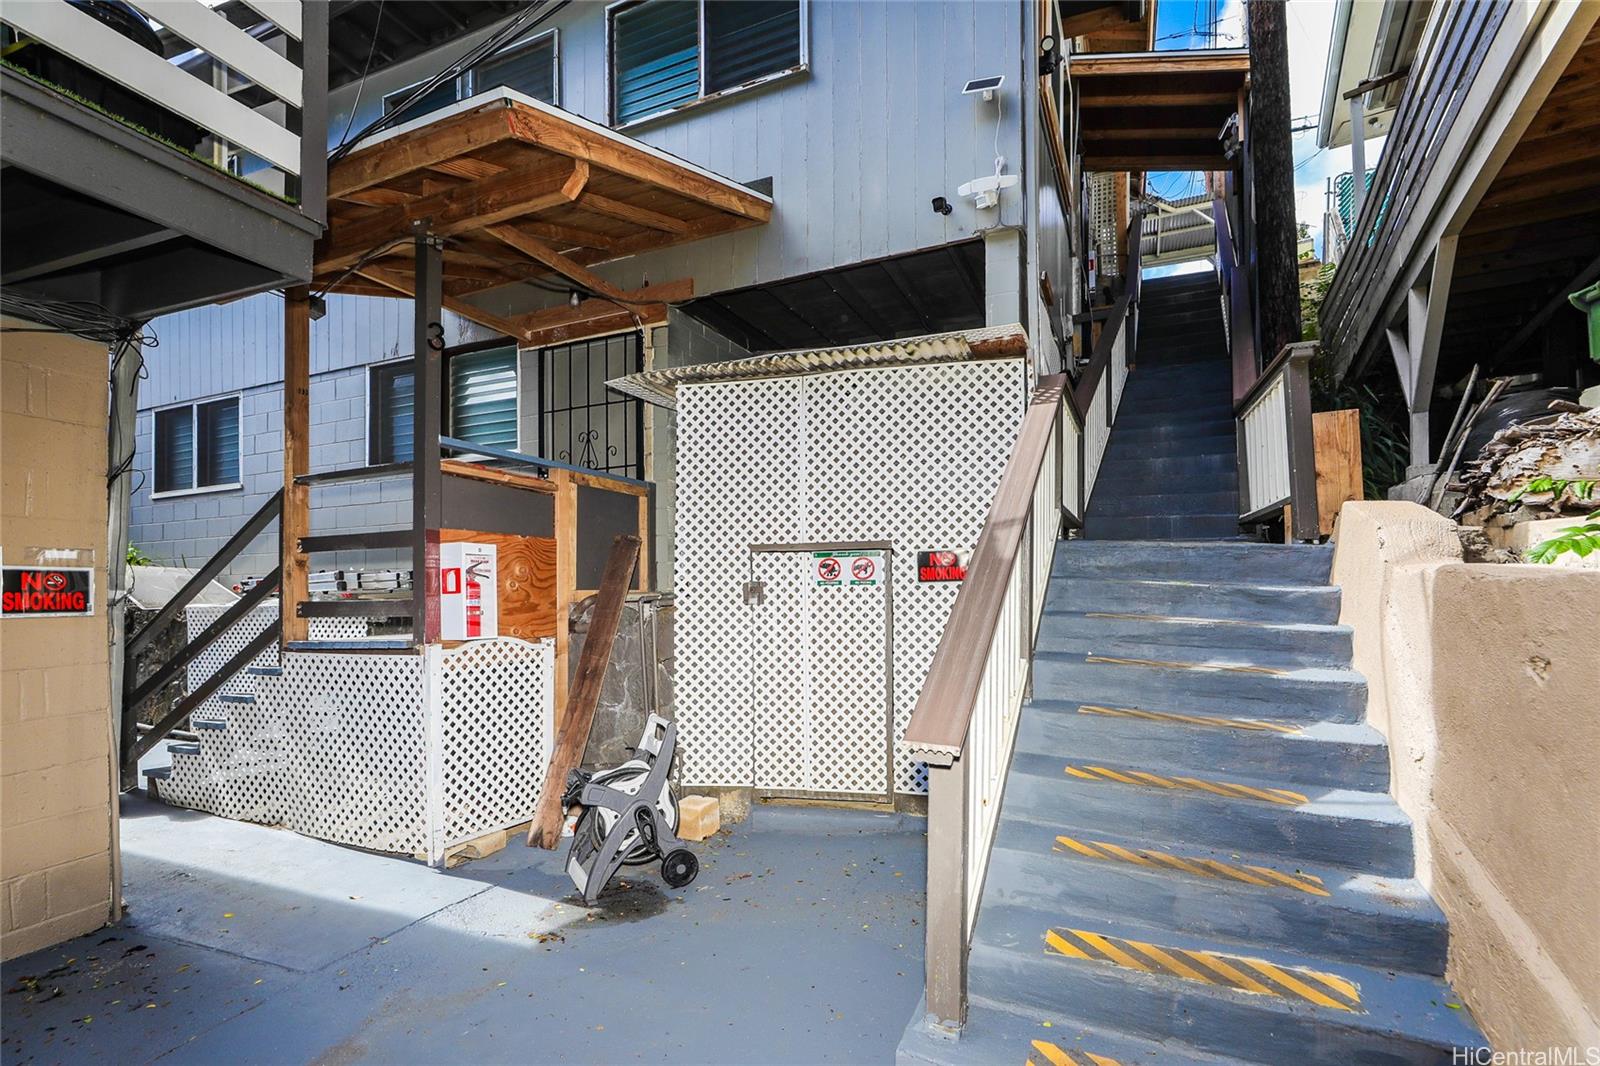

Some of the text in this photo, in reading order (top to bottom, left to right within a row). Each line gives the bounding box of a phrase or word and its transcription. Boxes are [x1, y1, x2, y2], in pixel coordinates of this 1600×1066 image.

[427, 322, 445, 350] 3
[920, 566, 967, 580] SMOKING
[3, 591, 85, 611] SMOKING
